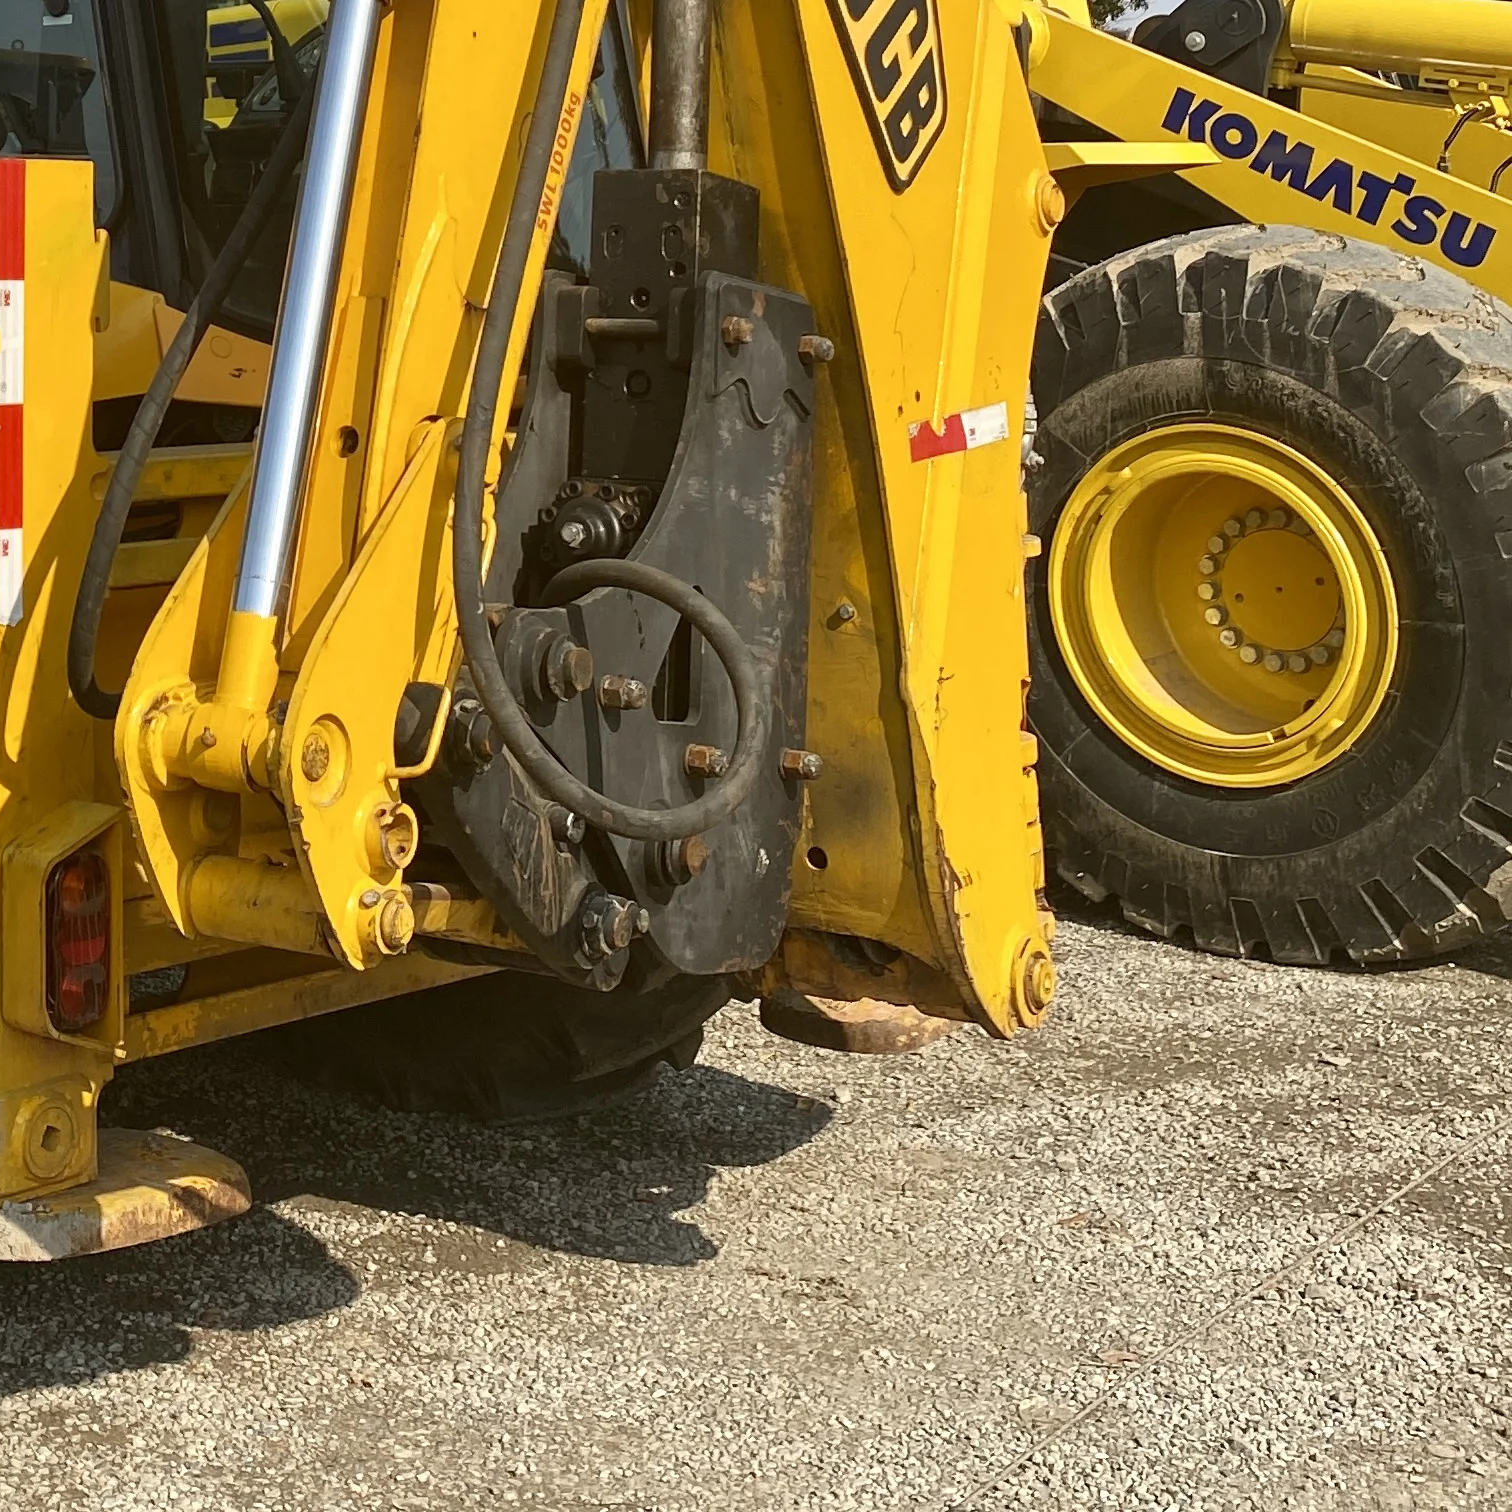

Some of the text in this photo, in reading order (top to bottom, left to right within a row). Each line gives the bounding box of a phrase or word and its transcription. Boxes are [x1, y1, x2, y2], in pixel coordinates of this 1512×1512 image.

[537, 91, 581, 232] SWL 1000kg
[1161, 86, 1497, 268] KOMATSU
